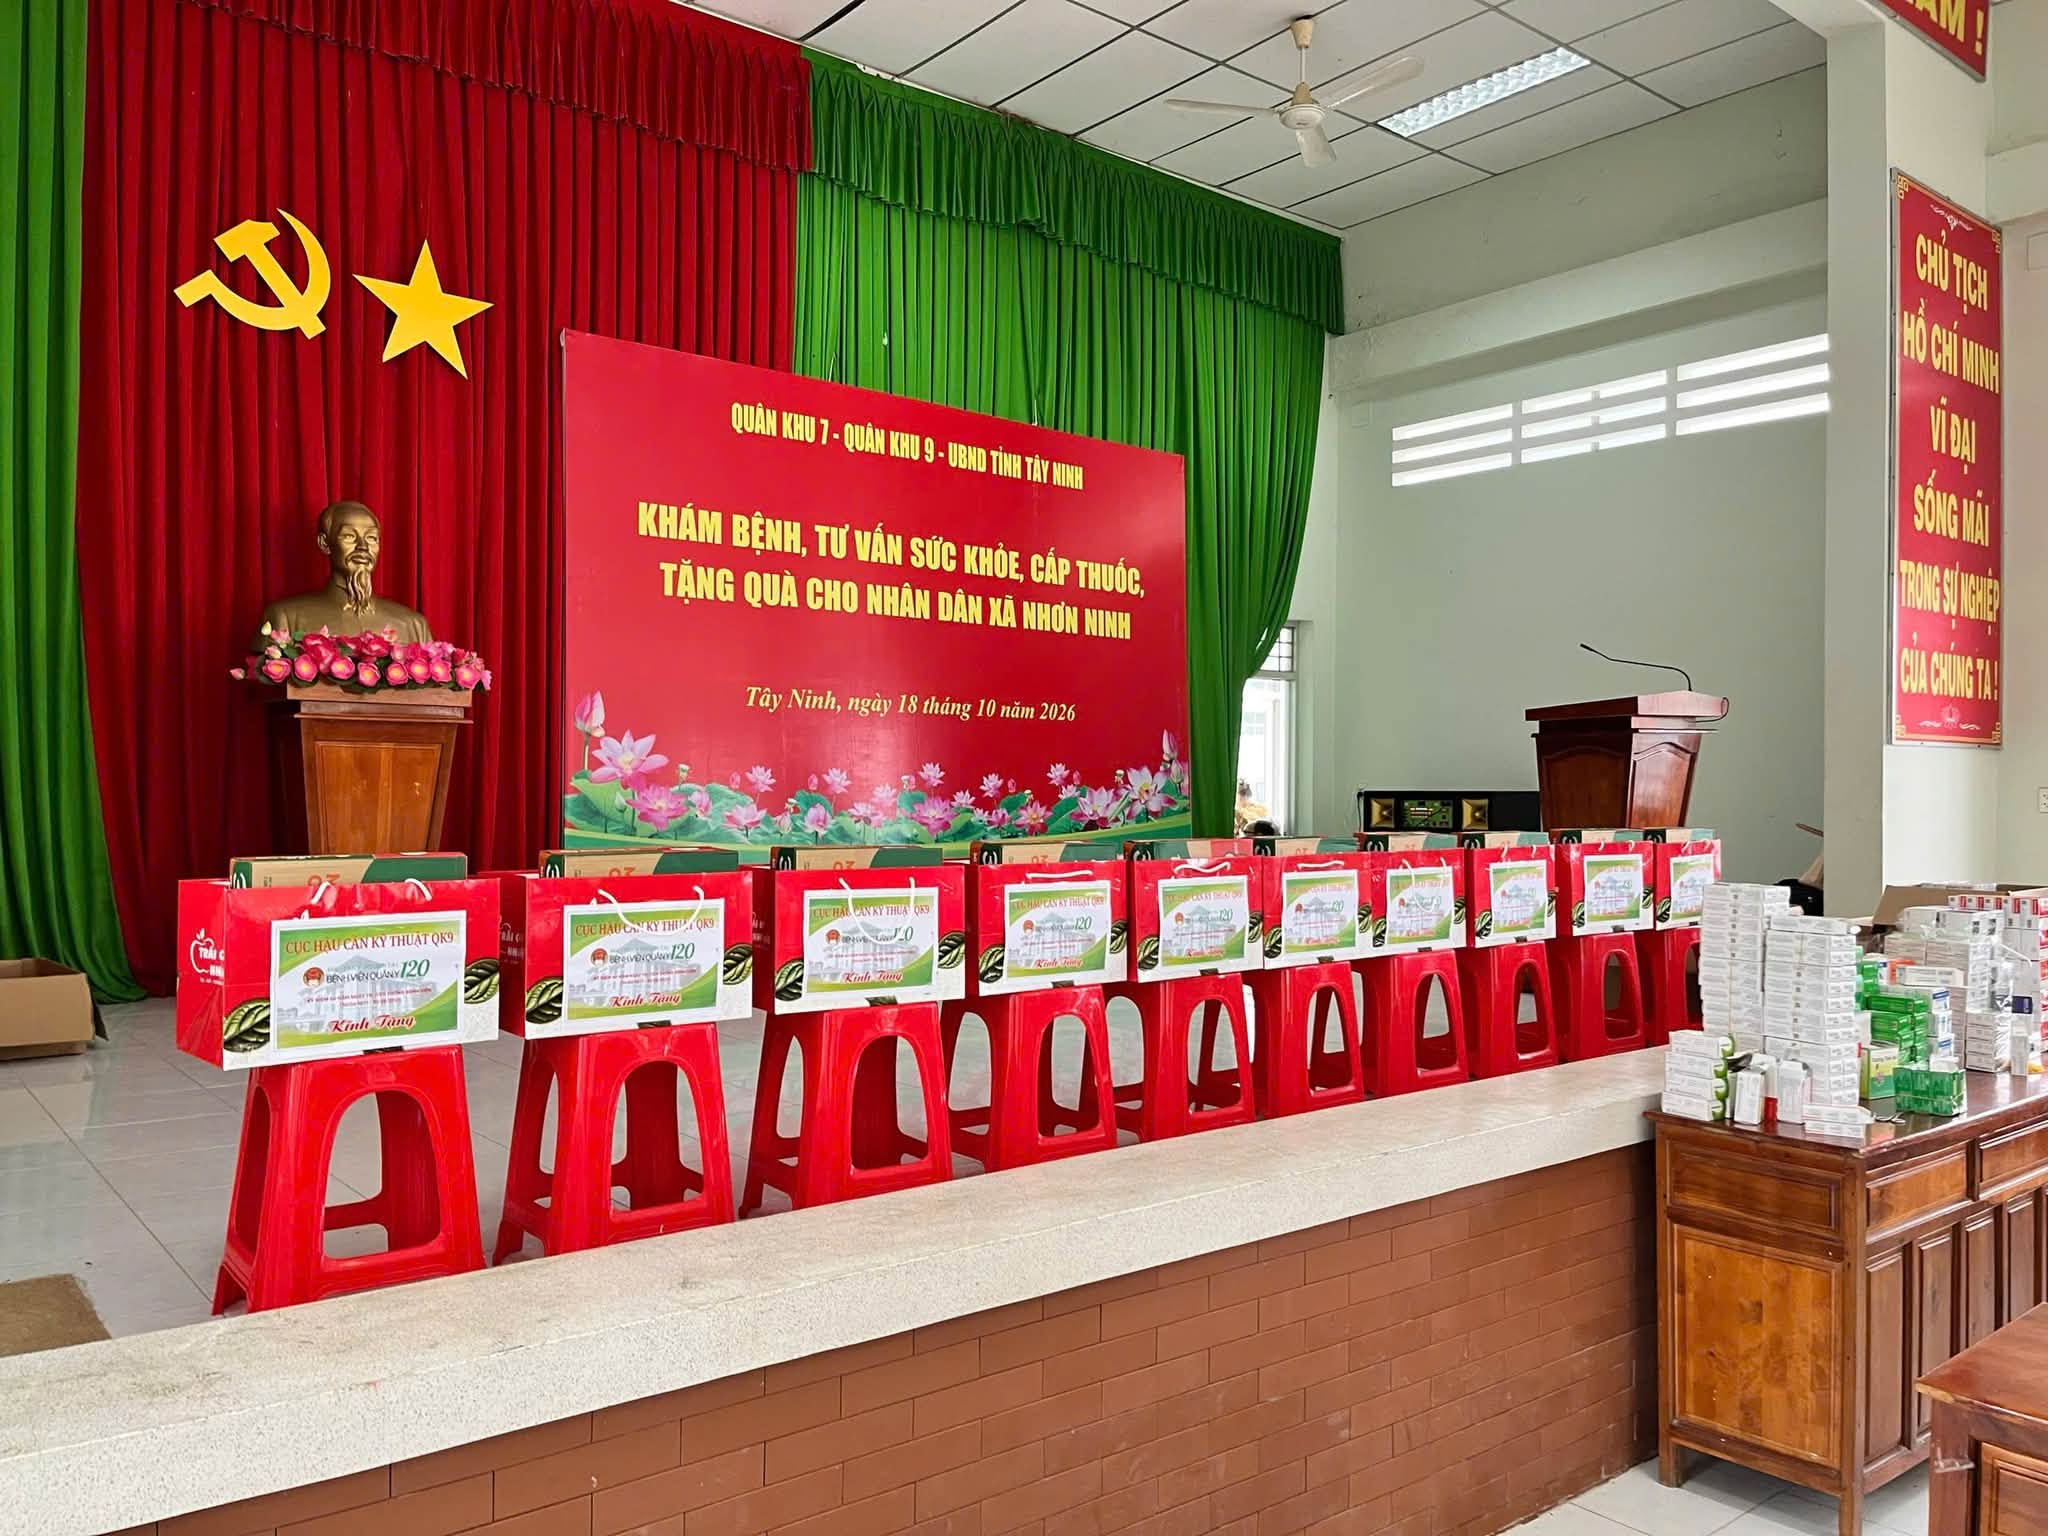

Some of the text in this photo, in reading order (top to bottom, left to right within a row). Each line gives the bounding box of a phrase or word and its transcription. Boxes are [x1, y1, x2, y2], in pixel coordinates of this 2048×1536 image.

[1915, 229, 1988, 315] CHỦ TỊCH
[1902, 297, 1999, 394] HỒ CHÍ MINH
[731, 402, 777, 437] QUÂN
[782, 411, 816, 443] KHU
[819, 418, 829, 445] 7
[843, 422, 885, 455] QUÂN
[889, 430, 920, 461] KHU
[924, 436, 935, 464] 9
[948, 441, 987, 473] UBND
[989, 446, 1022, 479] TỈNH
[1024, 453, 1050, 484] TÂY
[1052, 461, 1084, 490] NINH
[1930, 396, 1976, 475] VĨ ĐẠI
[1913, 469, 1990, 547] SỐNG MÃI
[638, 501, 1145, 598] KHÁM BỆNH, TƯ VẤN SỨC KHỎE, CẤP THUỐC,
[659, 559, 1131, 640] TẶNG QUÀ CHO NHÂN DÂN XÃ NHƠN NINH
[1899, 559, 2000, 636] TRONG SỰ NGHIỆP
[746, 686, 1077, 721] Tây Ninh, ngày 18 tháng 10 năm 2026
[1900, 631, 1928, 695] CỦA
[1930, 641, 1975, 699] CHÚNG
[431, 931, 454, 947] QK9
[670, 942, 696, 960] 120
[1073, 915, 1093, 931] 120
[399, 958, 431, 979] 120
[329, 1017, 370, 1033] Kính
